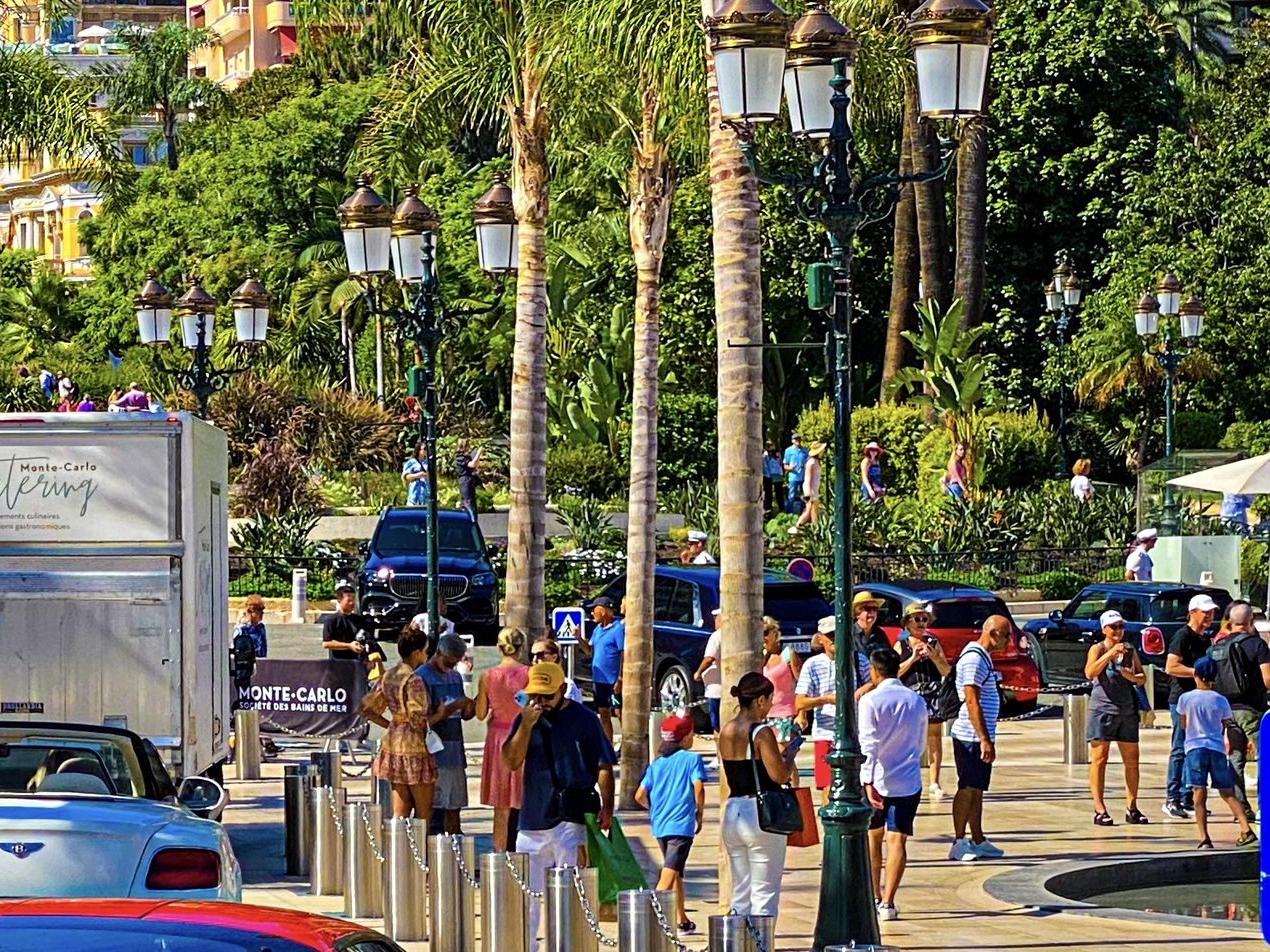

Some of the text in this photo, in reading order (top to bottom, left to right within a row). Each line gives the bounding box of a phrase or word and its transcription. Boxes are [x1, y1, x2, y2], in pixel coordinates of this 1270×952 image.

[20, 462, 97, 472] Monte-Carlo
[27, 512, 61, 520] culinaires
[239, 701, 347, 713] SOCIÉTÉ DES BAINS DE MER
